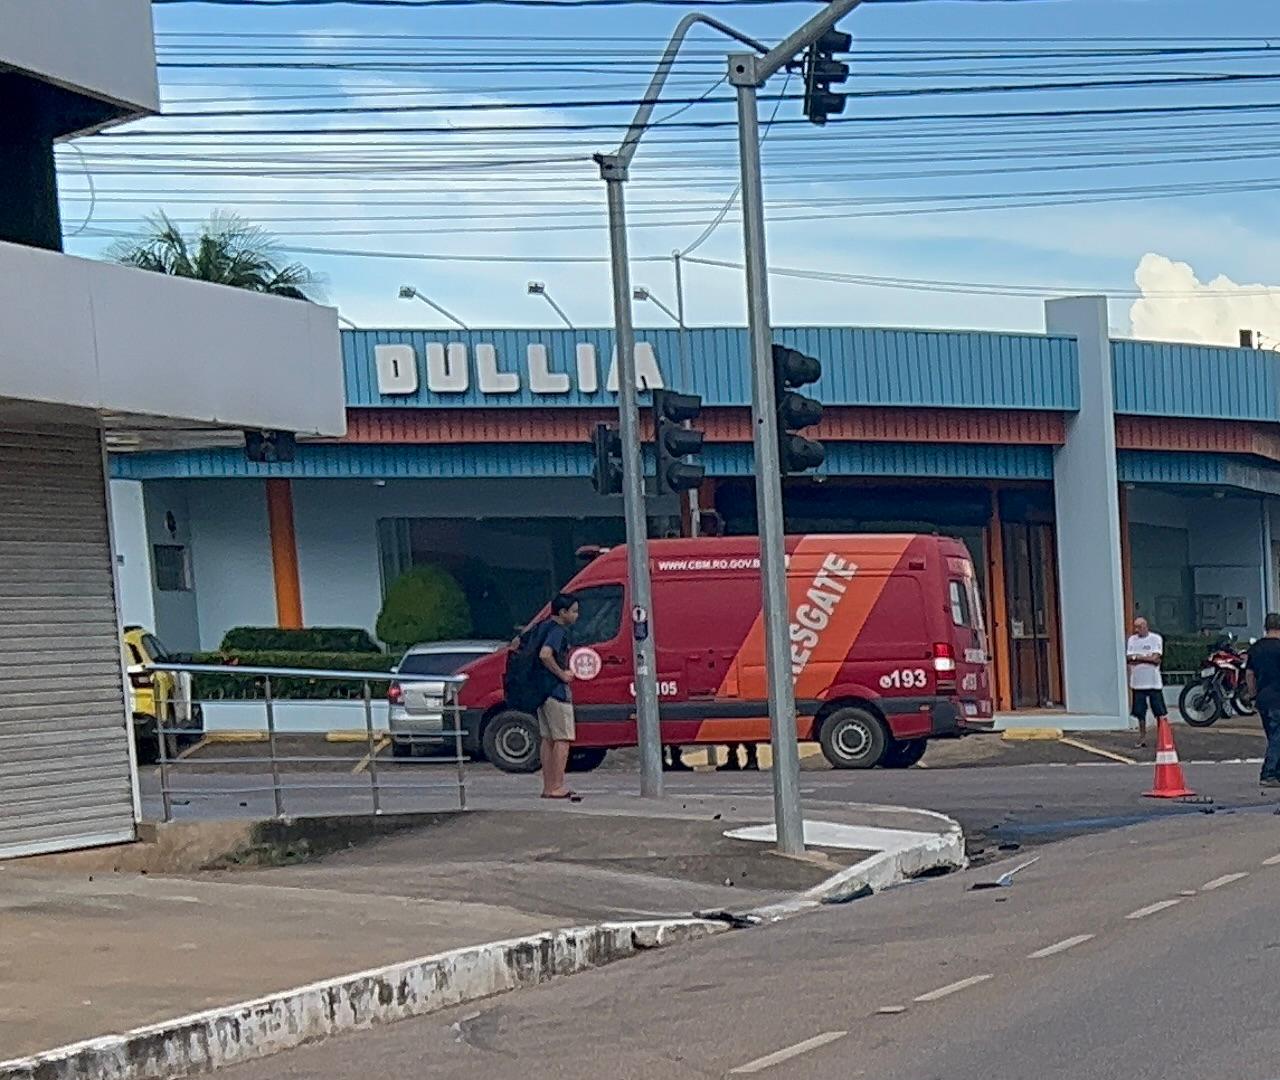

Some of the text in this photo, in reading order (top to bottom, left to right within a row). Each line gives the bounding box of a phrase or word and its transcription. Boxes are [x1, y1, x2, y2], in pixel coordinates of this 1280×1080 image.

[658, 558, 761, 571] WWW.CBM.RO.GOV.B
[788, 552, 859, 685] ESGATE
[889, 668, 928, 689] 193
